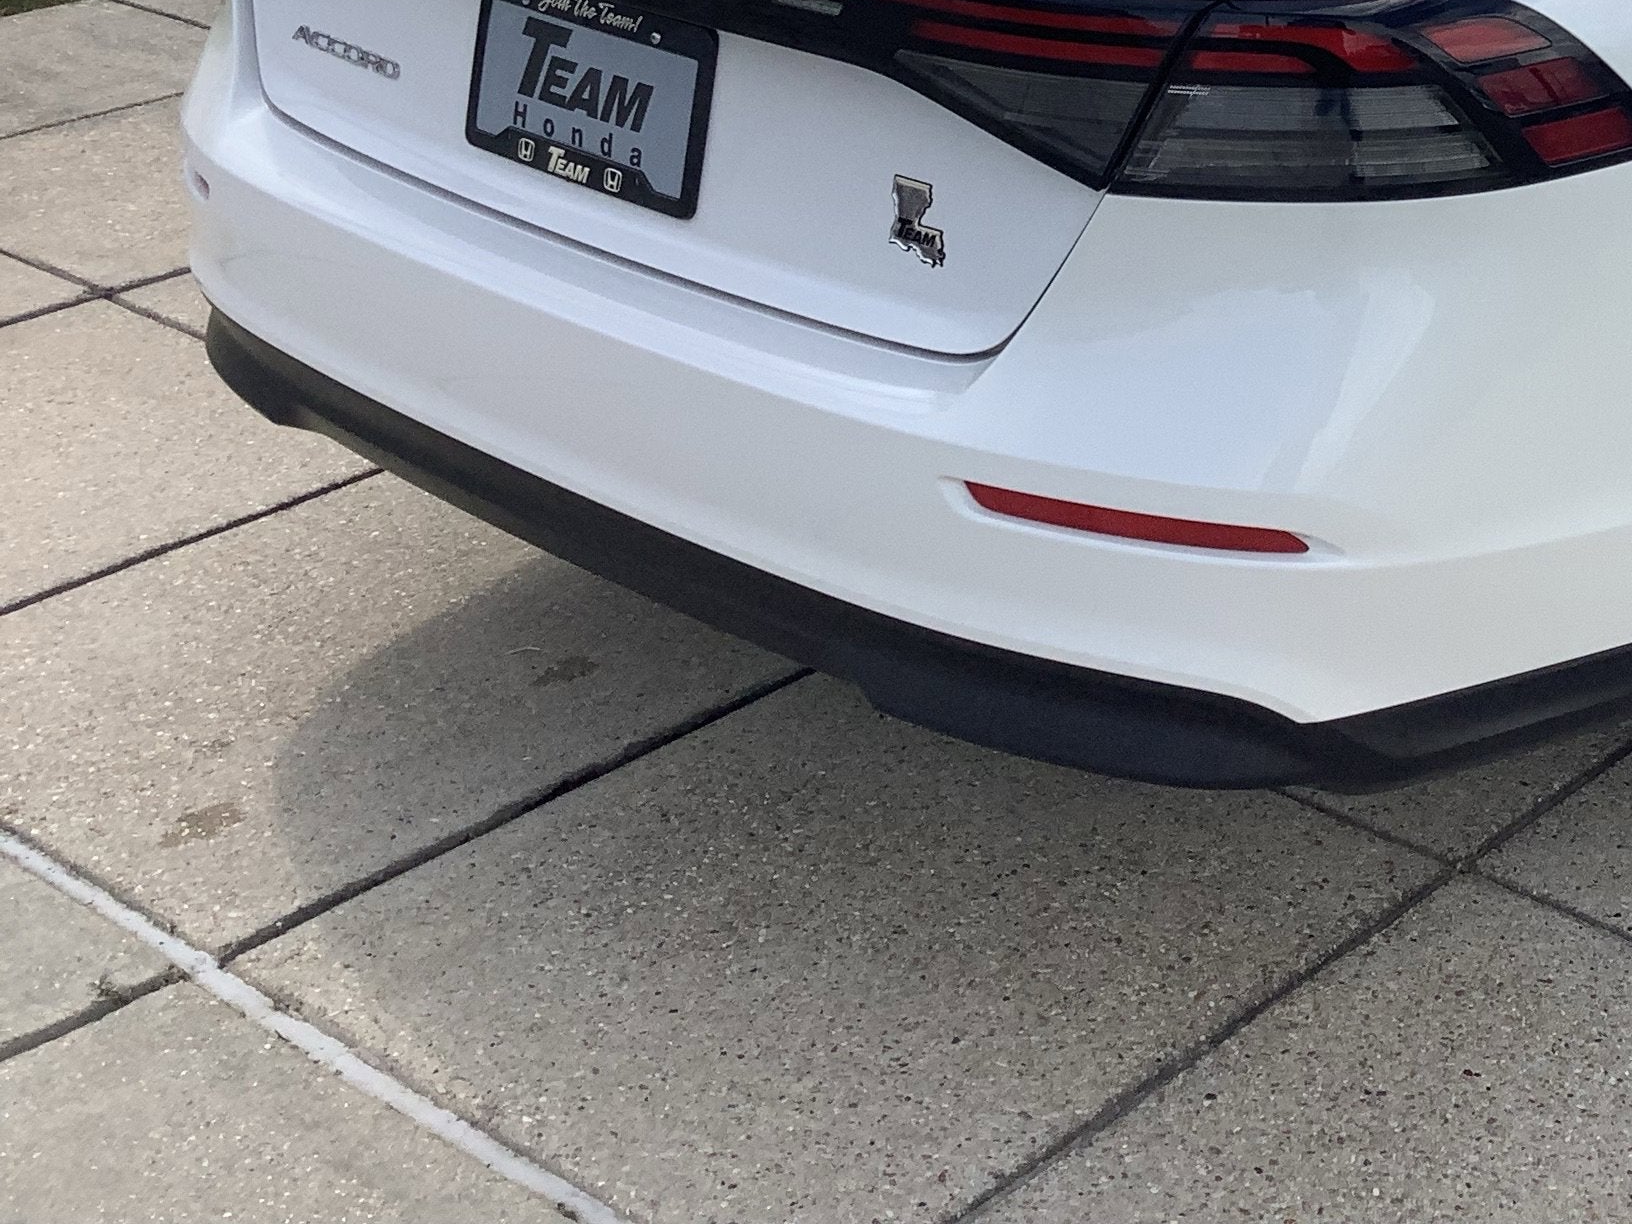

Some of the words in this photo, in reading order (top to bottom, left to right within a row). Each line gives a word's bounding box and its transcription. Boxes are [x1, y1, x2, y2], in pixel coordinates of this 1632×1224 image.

[598, 2, 643, 33] Team!
[292, 25, 400, 80] ACCORD
[517, 16, 654, 133] TEAM
[513, 101, 642, 168] Honda
[547, 145, 590, 184] TEAM
[897, 217, 937, 248] TEAM
